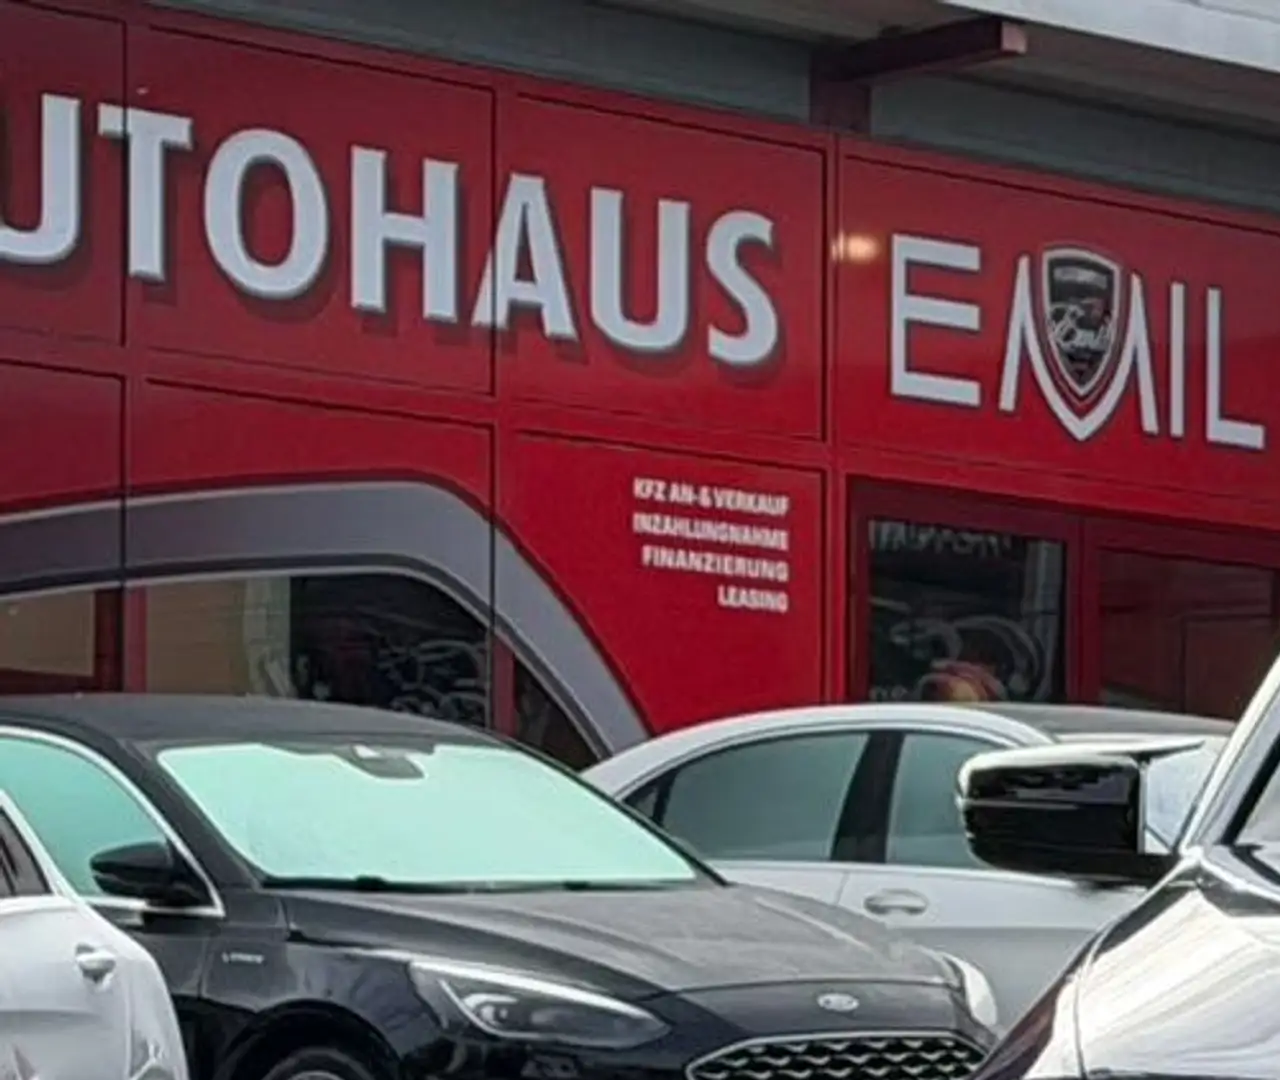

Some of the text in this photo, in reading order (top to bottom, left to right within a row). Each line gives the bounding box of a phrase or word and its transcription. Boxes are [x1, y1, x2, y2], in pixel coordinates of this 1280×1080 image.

[890, 233, 1267, 450] EMIL
[633, 477, 667, 500] KFZ
[713, 487, 790, 517] VERKAUF
[641, 545, 790, 582] FINANZIERUNG
[717, 584, 789, 613] LEASING
